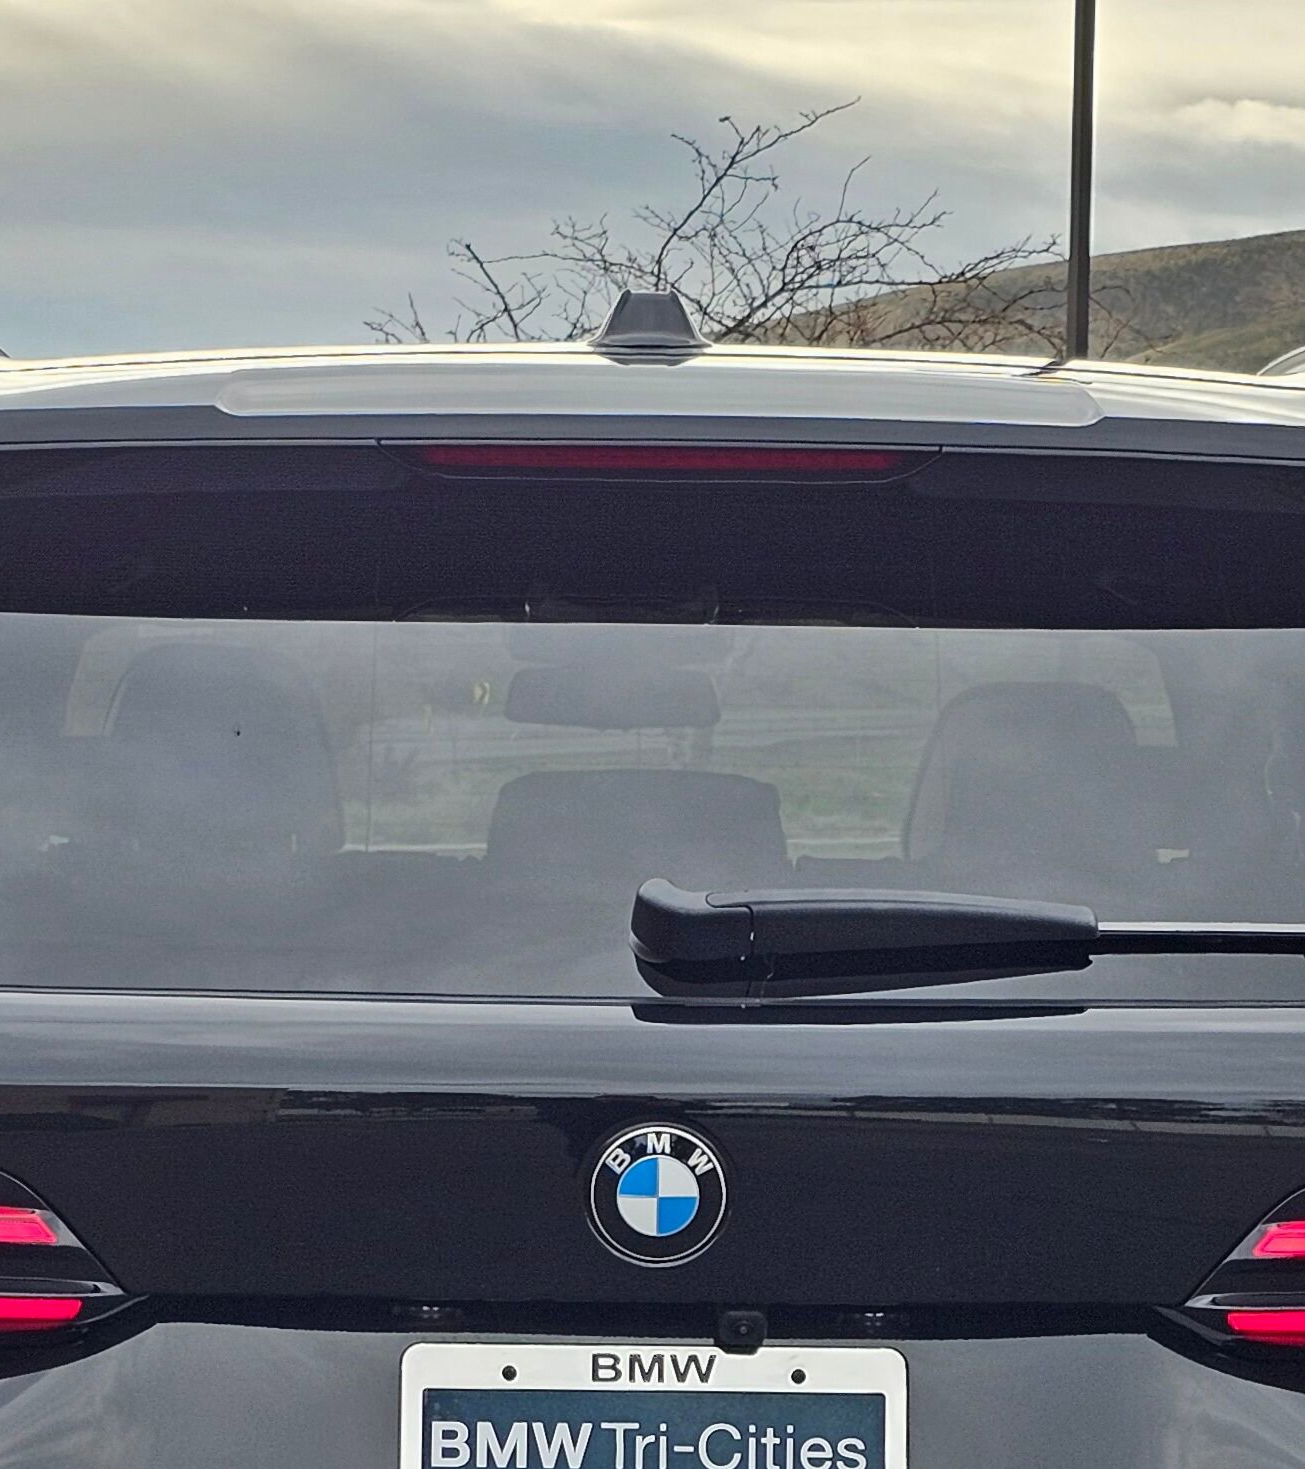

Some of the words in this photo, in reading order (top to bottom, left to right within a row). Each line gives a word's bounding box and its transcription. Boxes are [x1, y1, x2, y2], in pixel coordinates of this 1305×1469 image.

[605, 1132, 714, 1176] BMW
[591, 1354, 716, 1384] BMW
[431, 1421, 593, 1469] BMW
